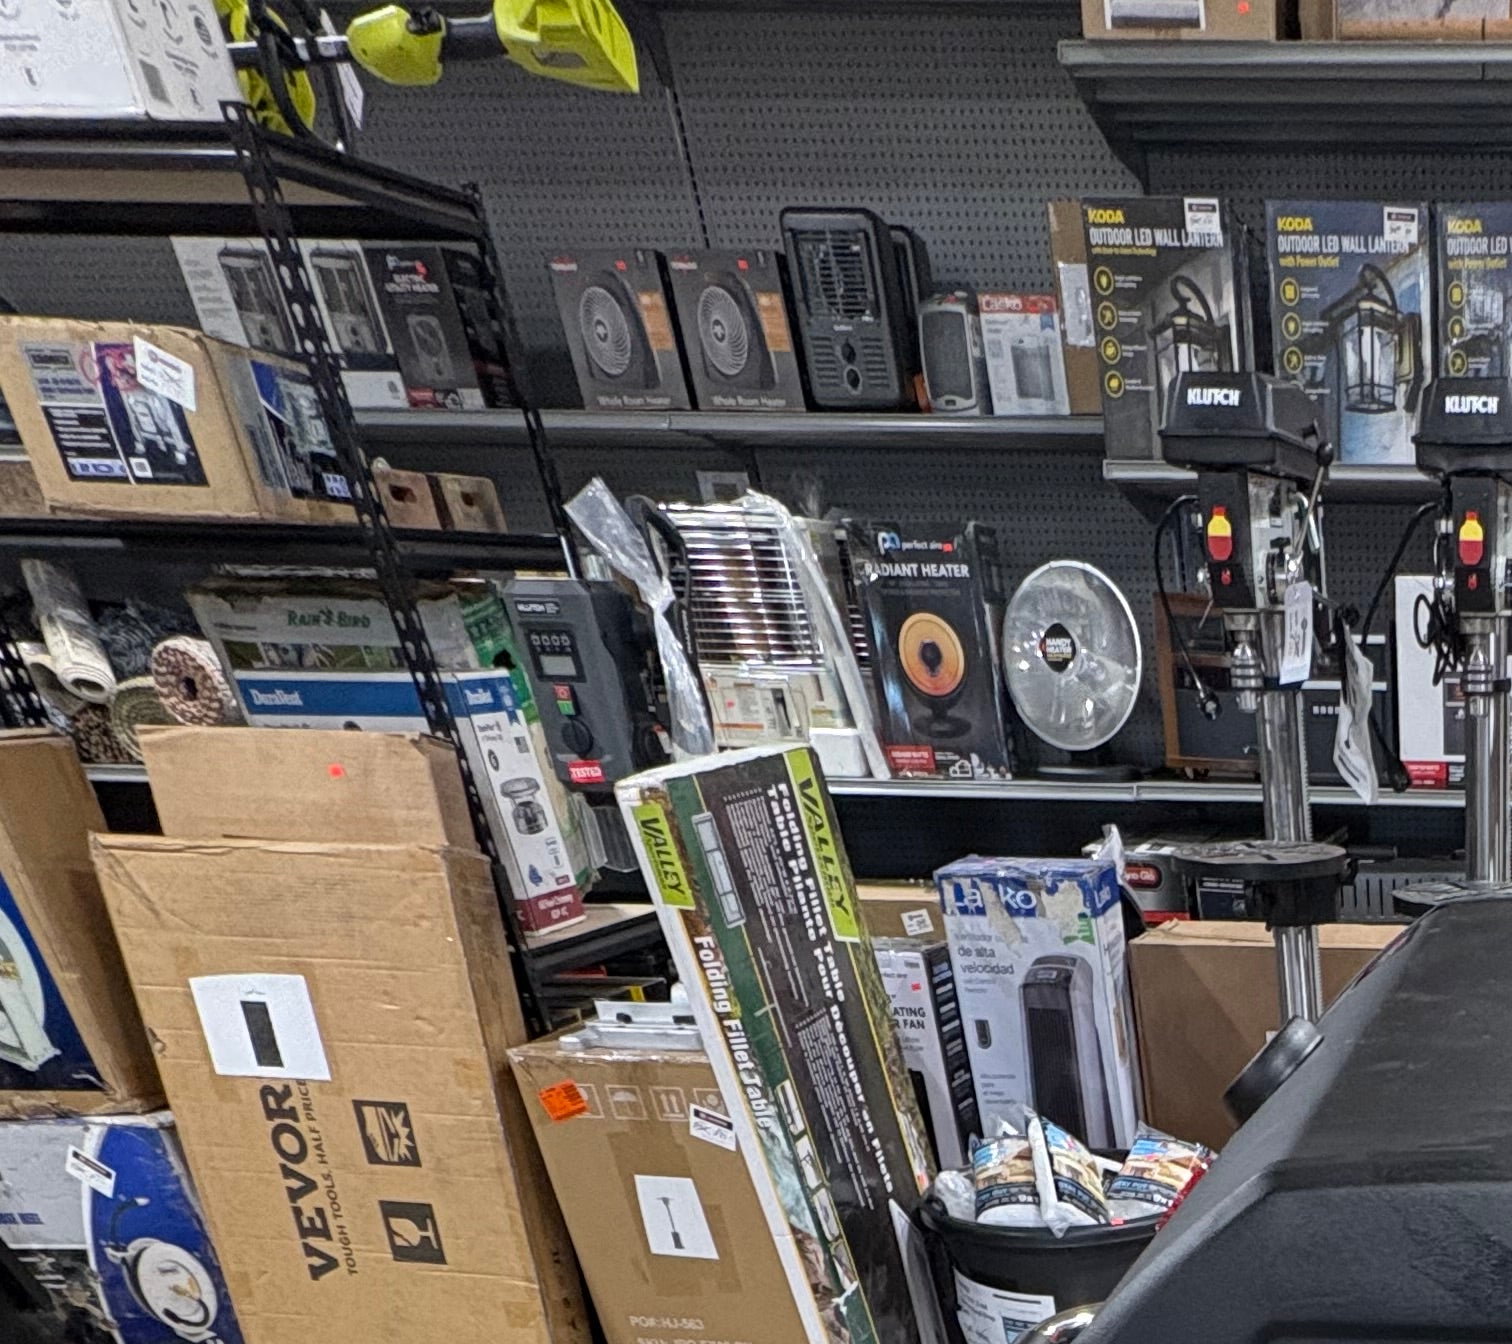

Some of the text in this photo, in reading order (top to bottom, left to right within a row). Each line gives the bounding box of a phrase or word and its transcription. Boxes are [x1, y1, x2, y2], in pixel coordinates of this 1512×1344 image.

[1087, 208, 1125, 224] KODA
[1276, 216, 1313, 232] KODA
[1446, 218, 1483, 234] KODA
[1088, 227, 1224, 248] OUTDOOR LED WALL LANTERN
[1277, 234, 1410, 254] OUTDOOR LED WALL LANTERN
[1447, 236, 1489, 255] OUTDOOR
[1490, 236, 1508, 255] LED
[1296, 256, 1317, 268] Power
[1186, 387, 1241, 407] KLUTCH
[1444, 395, 1500, 414] KLUTCH
[901, 540, 928, 552] perfect
[864, 562, 970, 580] RADIANT HEATER
[287, 609, 371, 629] RAIN BIRD
[569, 766, 603, 779] TESTED
[639, 817, 685, 896] VALLEY
[797, 777, 850, 917] VALLEY
[777, 783, 845, 1003] Folding Fillet Table
[953, 882, 1037, 911] Lako
[958, 946, 996, 959] de alta
[960, 963, 1015, 976] velocidad
[766, 783, 791, 853] Table
[788, 859, 817, 942] Pliante
[812, 947, 834, 1000] Pour
[871, 1137, 894, 1194] Filets
[693, 936, 771, 1130] Folding Fillet Table
[903, 1019, 926, 1030] FAN
[311, 1124, 329, 1165] HALF
[259, 1083, 340, 1281] VEVOR
[337, 1224, 358, 1276] TOUGH
